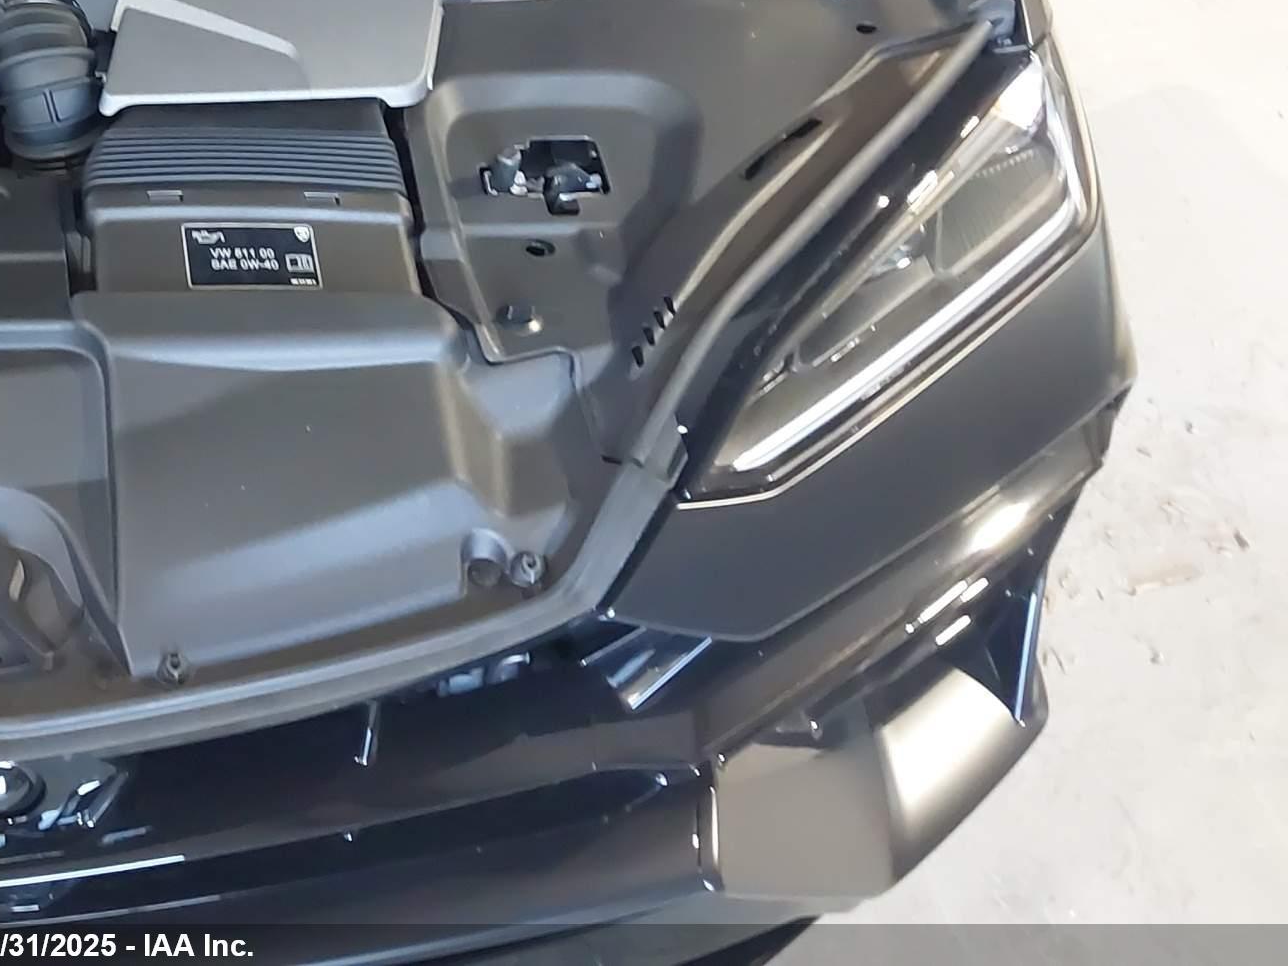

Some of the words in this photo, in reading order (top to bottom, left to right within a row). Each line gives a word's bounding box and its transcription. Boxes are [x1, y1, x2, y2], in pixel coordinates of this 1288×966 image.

[209, 247, 232, 259] VW
[259, 247, 275, 259] 00
[240, 258, 280, 271] 0W-40
